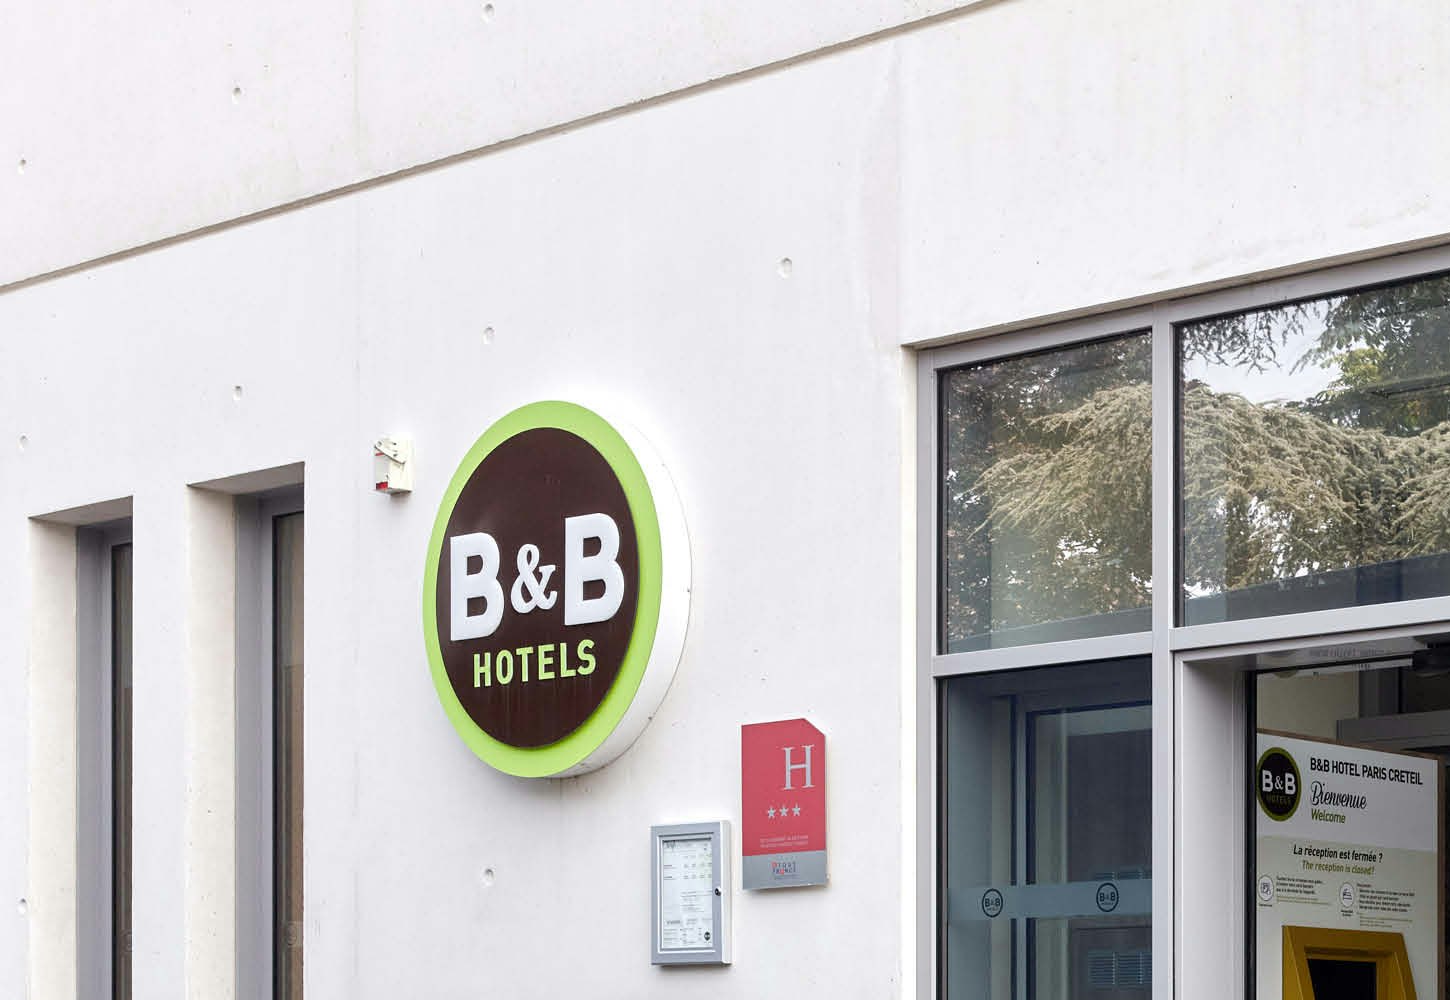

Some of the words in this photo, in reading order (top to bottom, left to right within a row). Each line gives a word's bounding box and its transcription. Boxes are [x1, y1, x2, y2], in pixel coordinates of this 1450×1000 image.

[450, 512, 625, 642] B&B
[473, 639, 597, 688] HOTELS
[780, 744, 817, 790] H
[1310, 757, 1330, 773] B&B
[1332, 760, 1361, 777] HOTEL
[1362, 764, 1387, 781] PARIS
[1388, 768, 1423, 786] CRETEIL
[1262, 769, 1296, 795] B&B
[1310, 780, 1367, 810] Bienvenue
[1311, 808, 1345, 824] Welcome
[1293, 844, 1303, 856] La
[1304, 845, 1338, 861] réception
[1338, 850, 1350, 861] est
[1351, 850, 1377, 864] fermée
[1302, 860, 1314, 871] The
[1315, 862, 1344, 874] reception
[985, 898, 1000, 907] B&B
[1099, 891, 1116, 902] B&B
